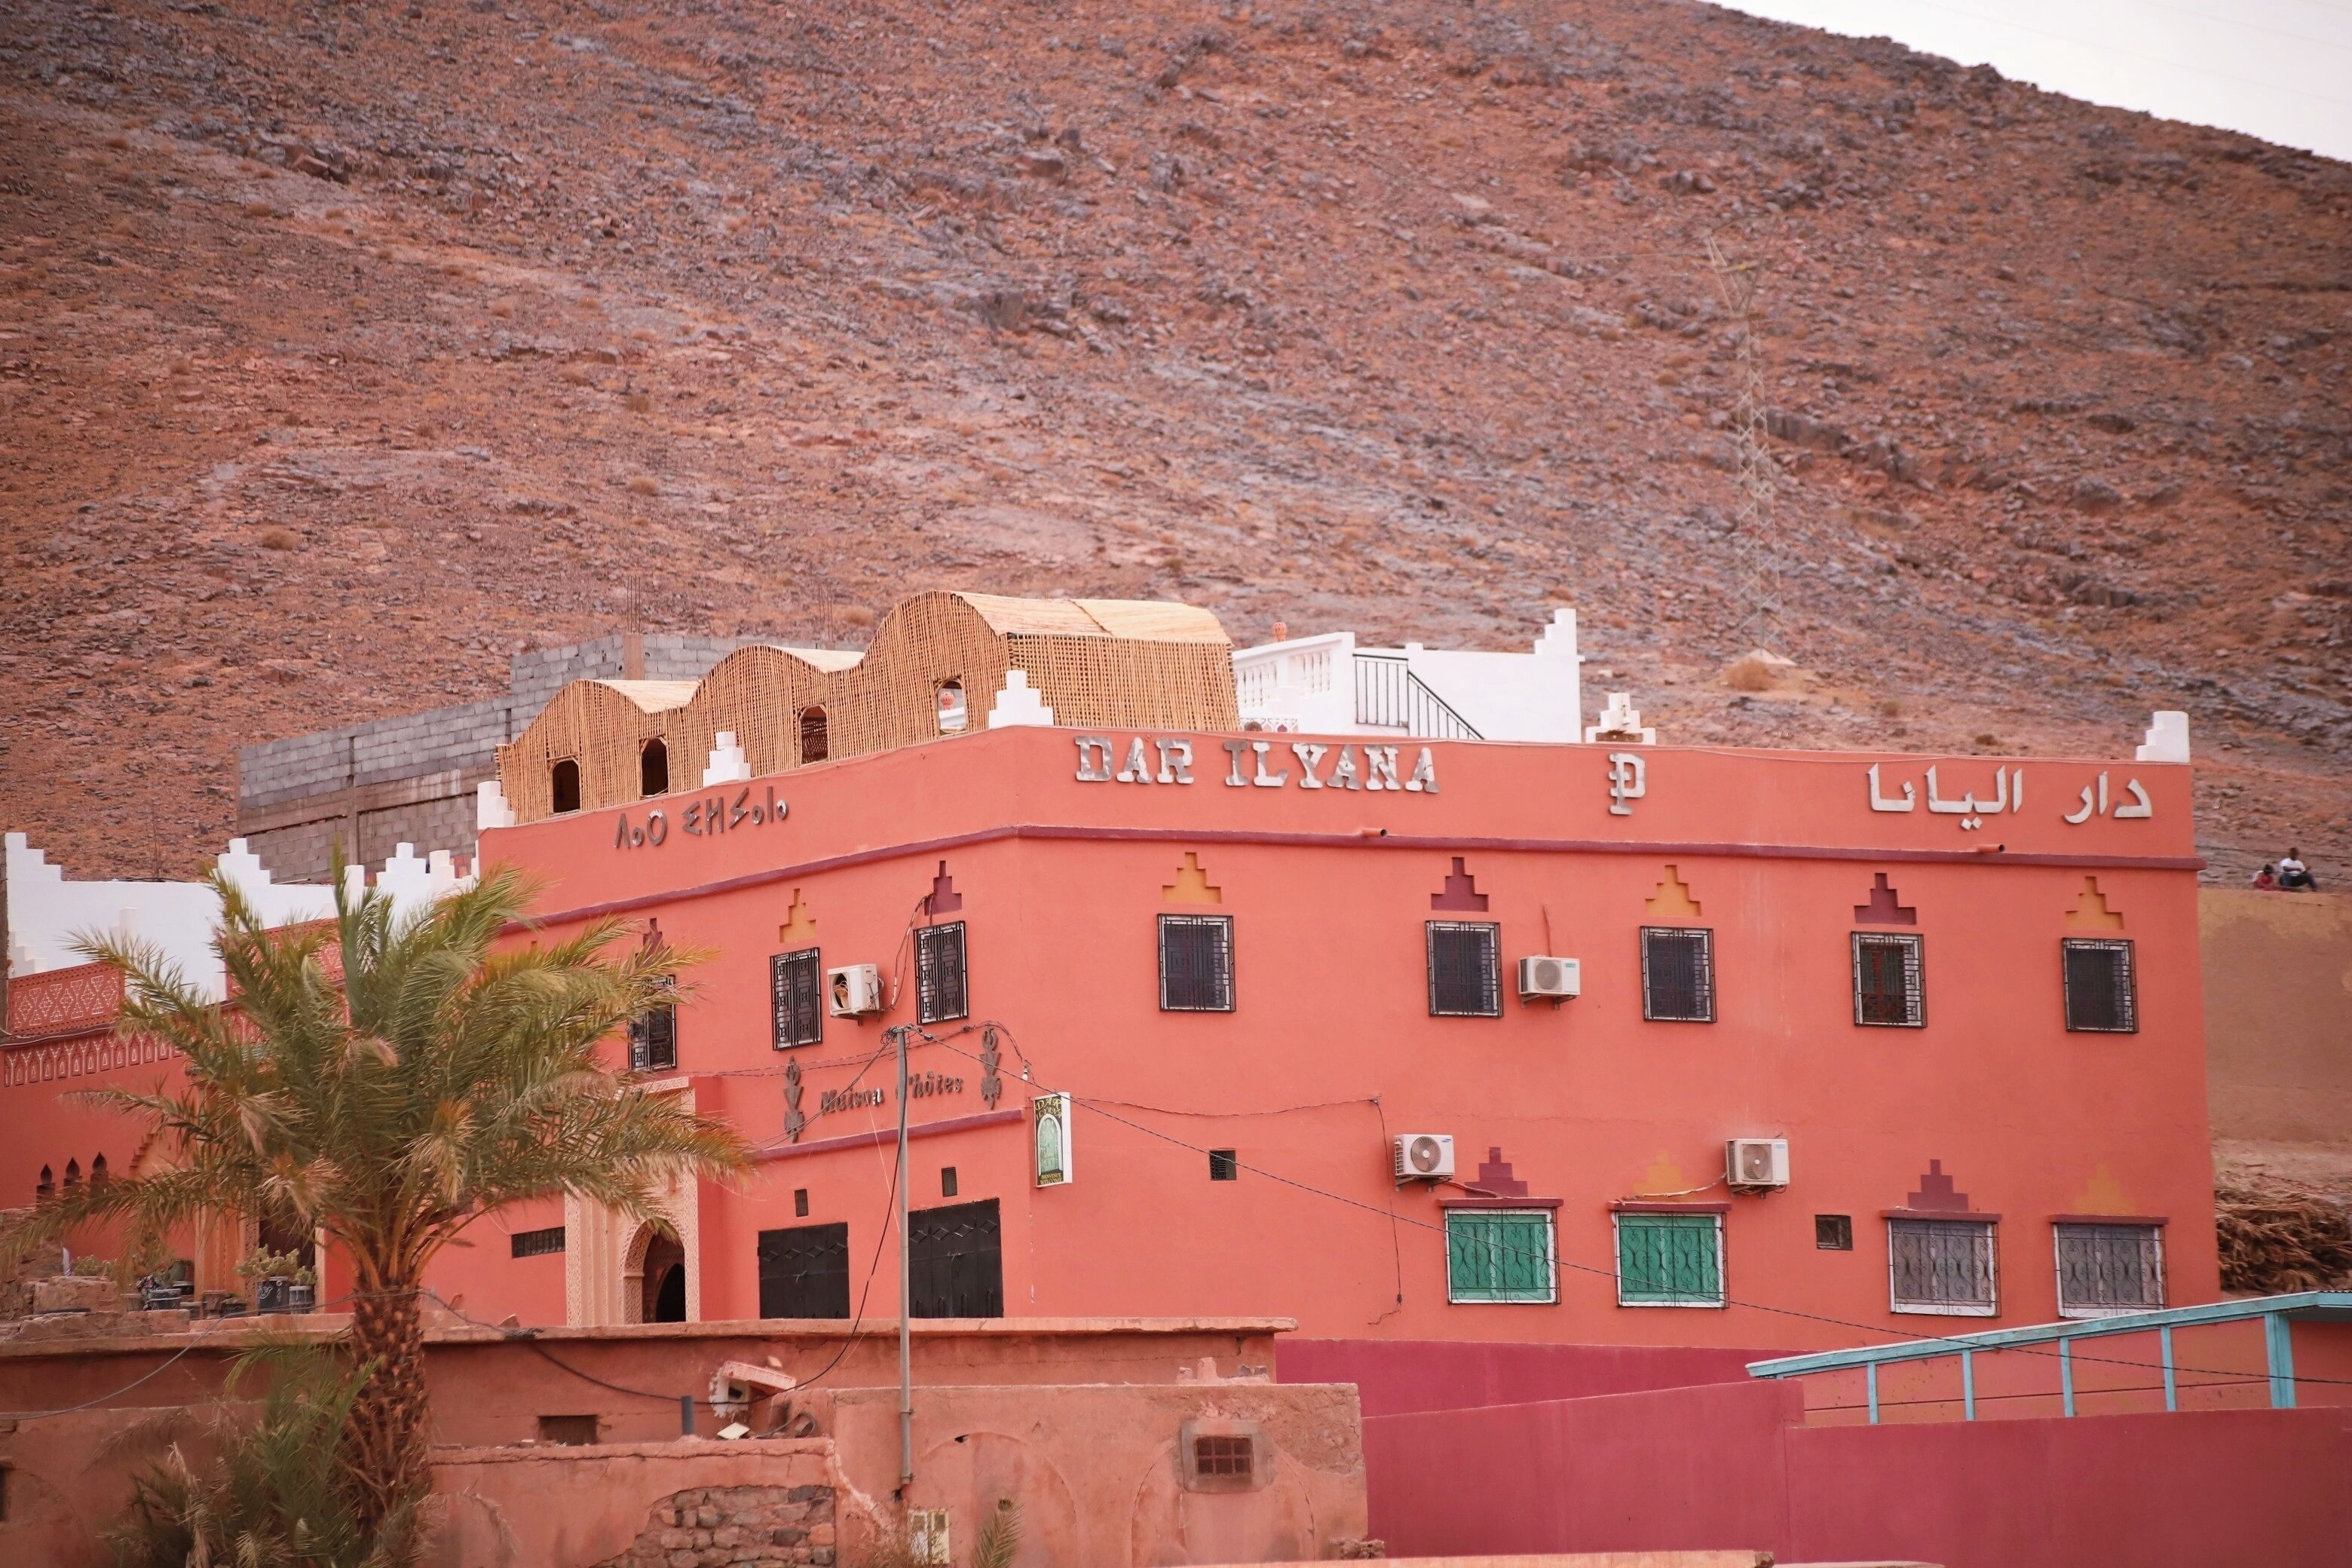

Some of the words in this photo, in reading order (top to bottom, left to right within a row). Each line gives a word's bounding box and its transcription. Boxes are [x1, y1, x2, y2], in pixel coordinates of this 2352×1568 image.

[1074, 736, 1195, 785] DAR
[1222, 741, 1441, 794] ILYANA
[2063, 770, 2153, 825] دار
[821, 1085, 886, 1116] Maison
[895, 1069, 964, 1099] 'hôtes
[1036, 1097, 1061, 1110] DAR
